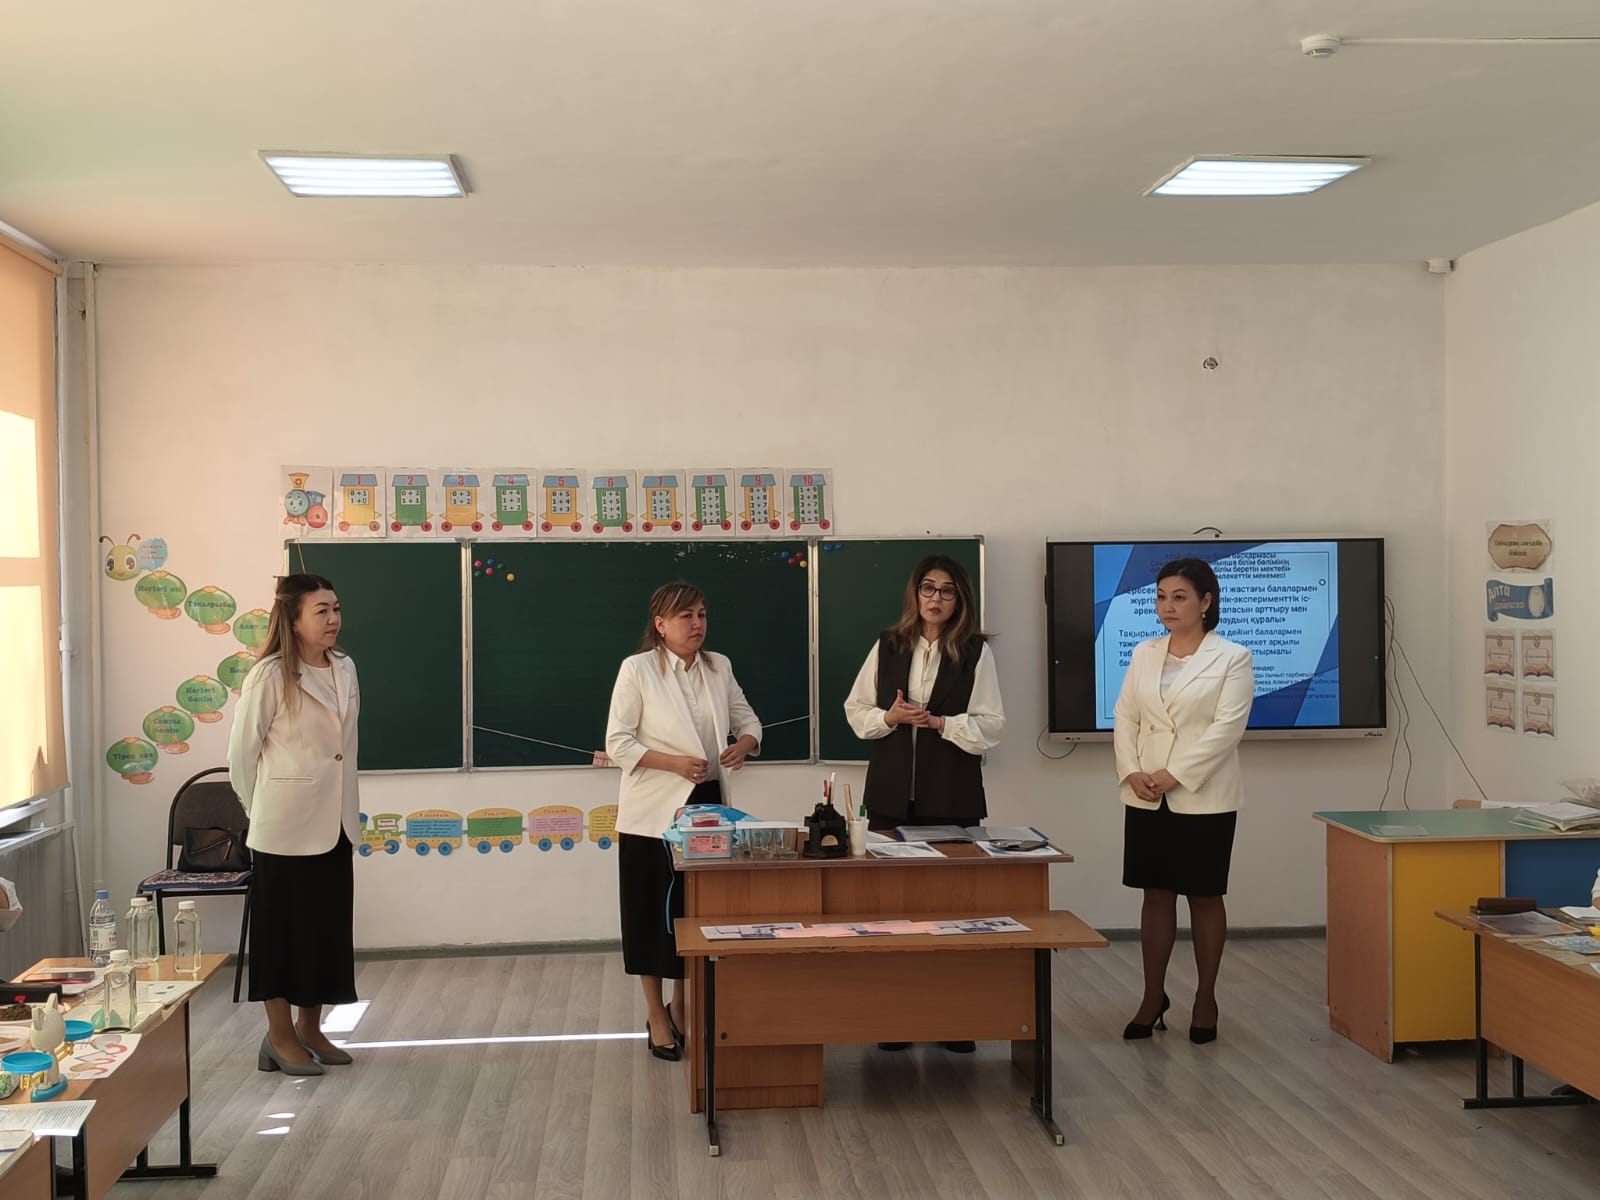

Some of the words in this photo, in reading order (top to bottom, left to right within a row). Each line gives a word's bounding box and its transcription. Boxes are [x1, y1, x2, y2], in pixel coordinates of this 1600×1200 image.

[355, 474, 362, 485] 1
[407, 475, 415, 486] 2
[457, 476, 465, 486] 3
[508, 474, 515, 485] 4
[558, 476, 565, 487] 5
[607, 476, 614, 488] 6
[657, 476, 664, 487] 7
[706, 475, 713, 486] 8
[755, 475, 762, 486] 9
[803, 475, 814, 486] 10
[1229, 586, 1266, 594] жастағы
[1267, 584, 1318, 593] балалармен
[1255, 606, 1290, 615] арттыру
[1291, 605, 1308, 613] мен
[1227, 628, 1253, 637] дейінгі
[1255, 628, 1302, 637] балалармен
[1268, 639, 1300, 648] арқылы
[1251, 649, 1292, 657] стырмалы
